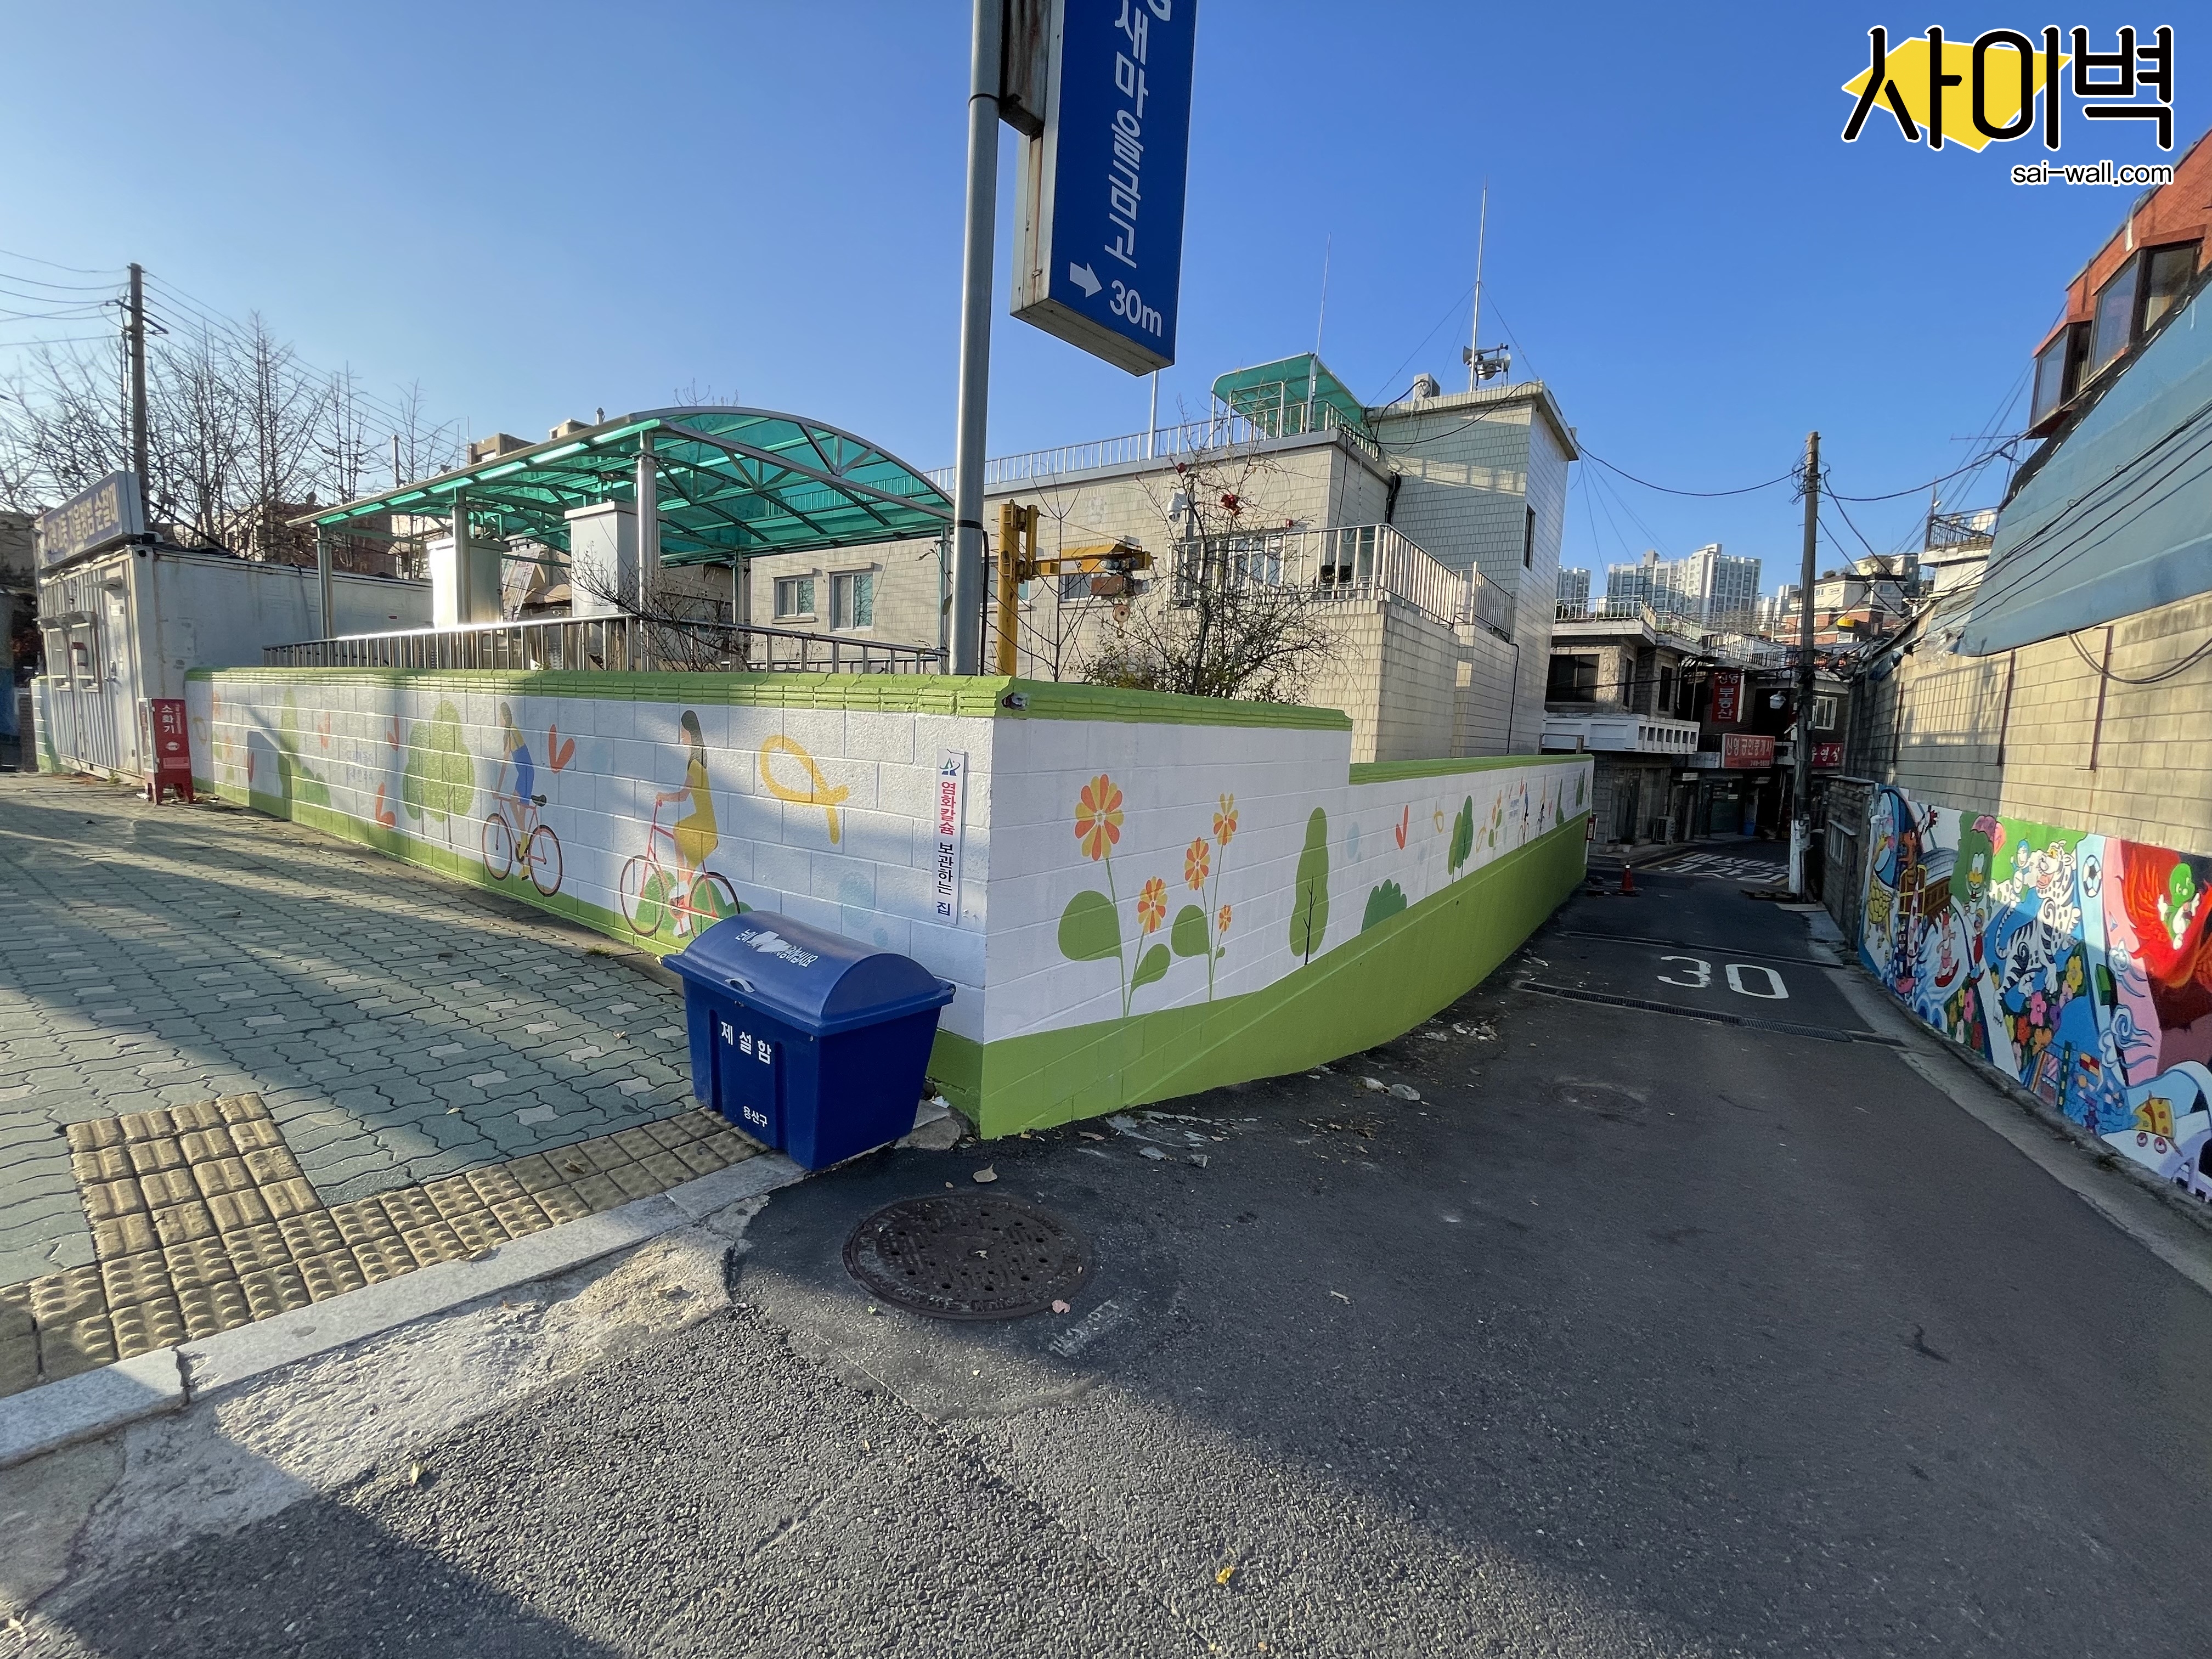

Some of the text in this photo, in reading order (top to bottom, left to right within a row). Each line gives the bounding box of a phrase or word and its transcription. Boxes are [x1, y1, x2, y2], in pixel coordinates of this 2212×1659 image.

[1104, 0, 1148, 268] 새마을금고
[1109, 280, 1161, 337] 30m
[161, 704, 174, 733] 소화기
[1717, 687, 1734, 719] 부동산
[936, 781, 956, 917] 염화칼슘 보관하는 집
[1657, 956, 1790, 999] 30
[743, 1105, 768, 1127] 용산구
